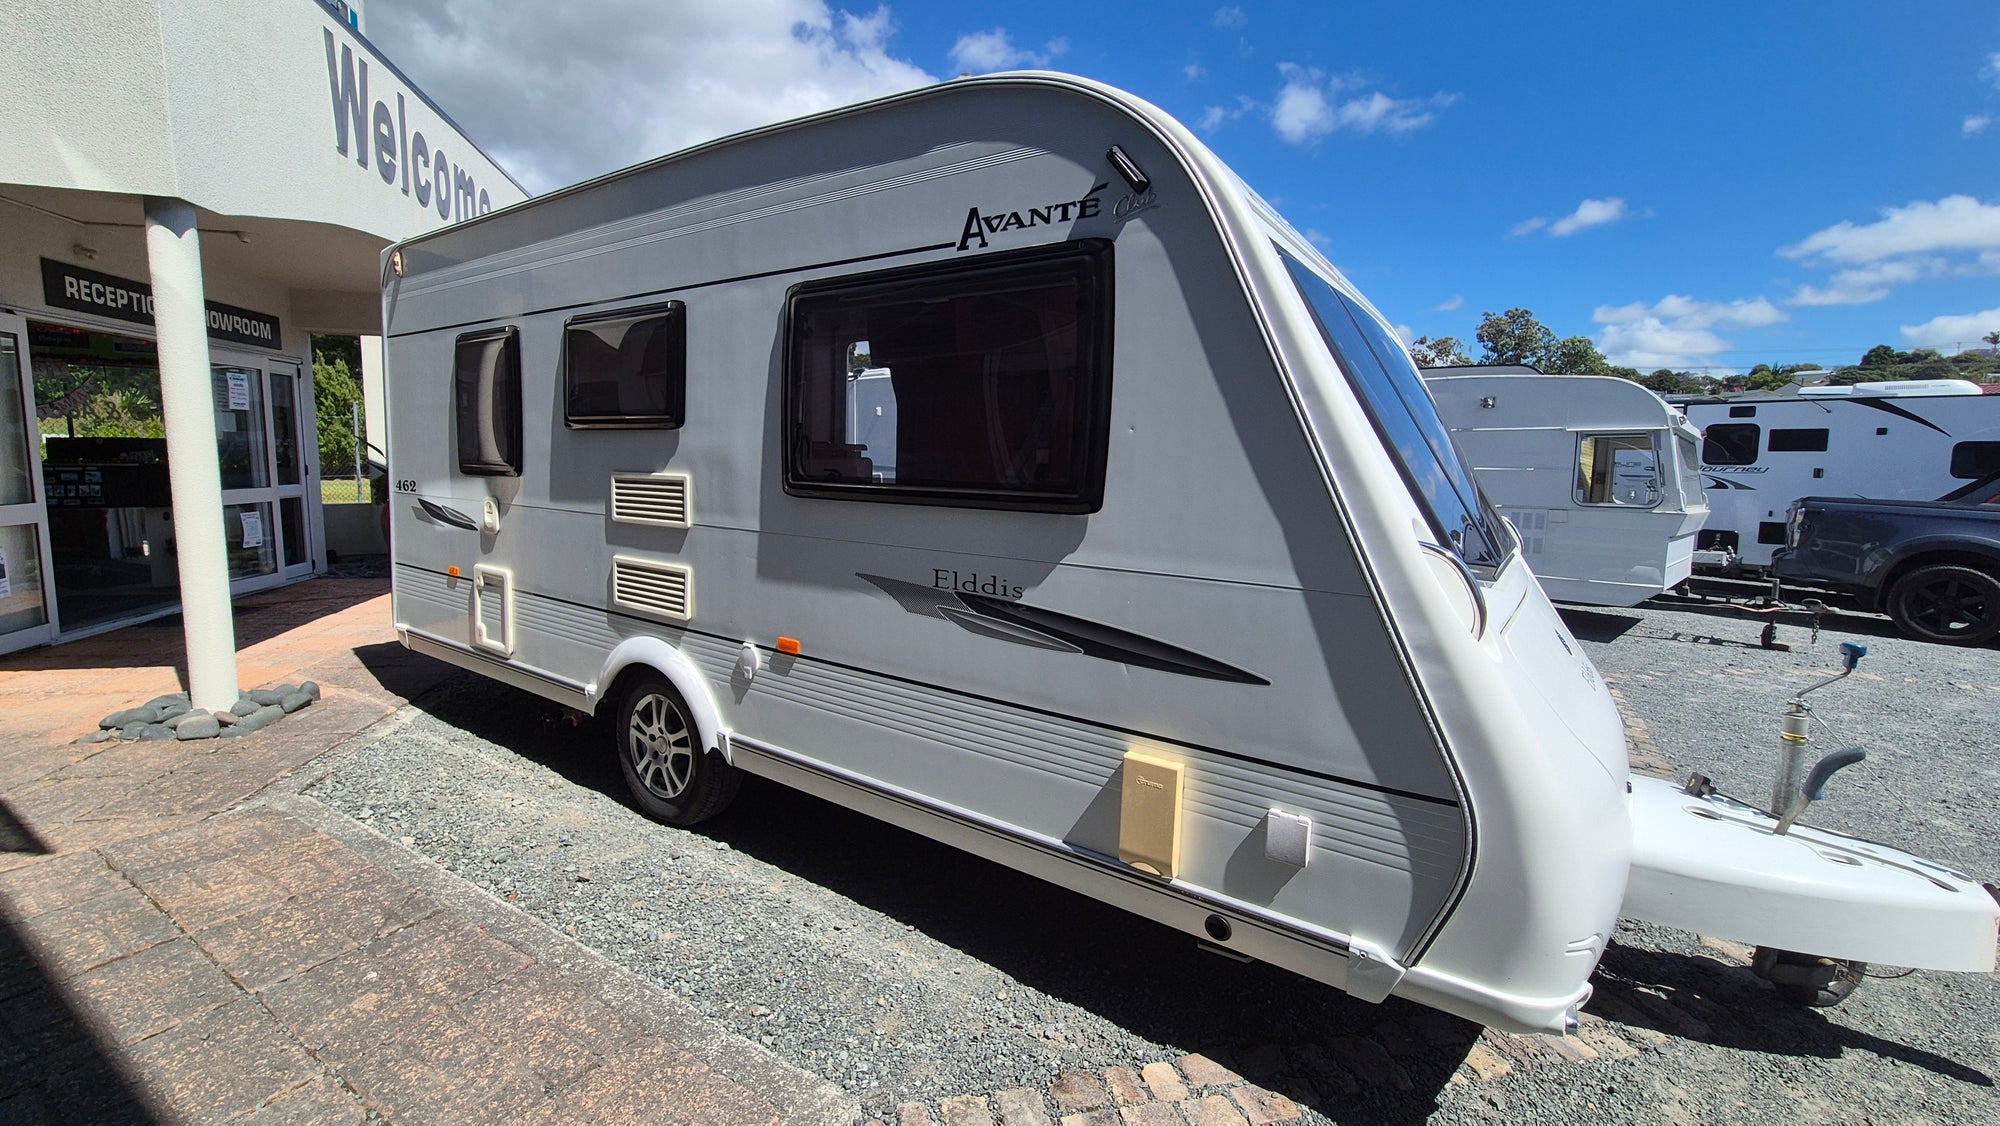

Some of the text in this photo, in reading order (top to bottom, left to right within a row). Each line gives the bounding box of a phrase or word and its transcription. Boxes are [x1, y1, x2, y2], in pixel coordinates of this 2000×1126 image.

[64, 276, 272, 340] RECEPTIO OWROOM
[395, 479, 416, 492] 462
[932, 568, 1024, 599] Elddis
